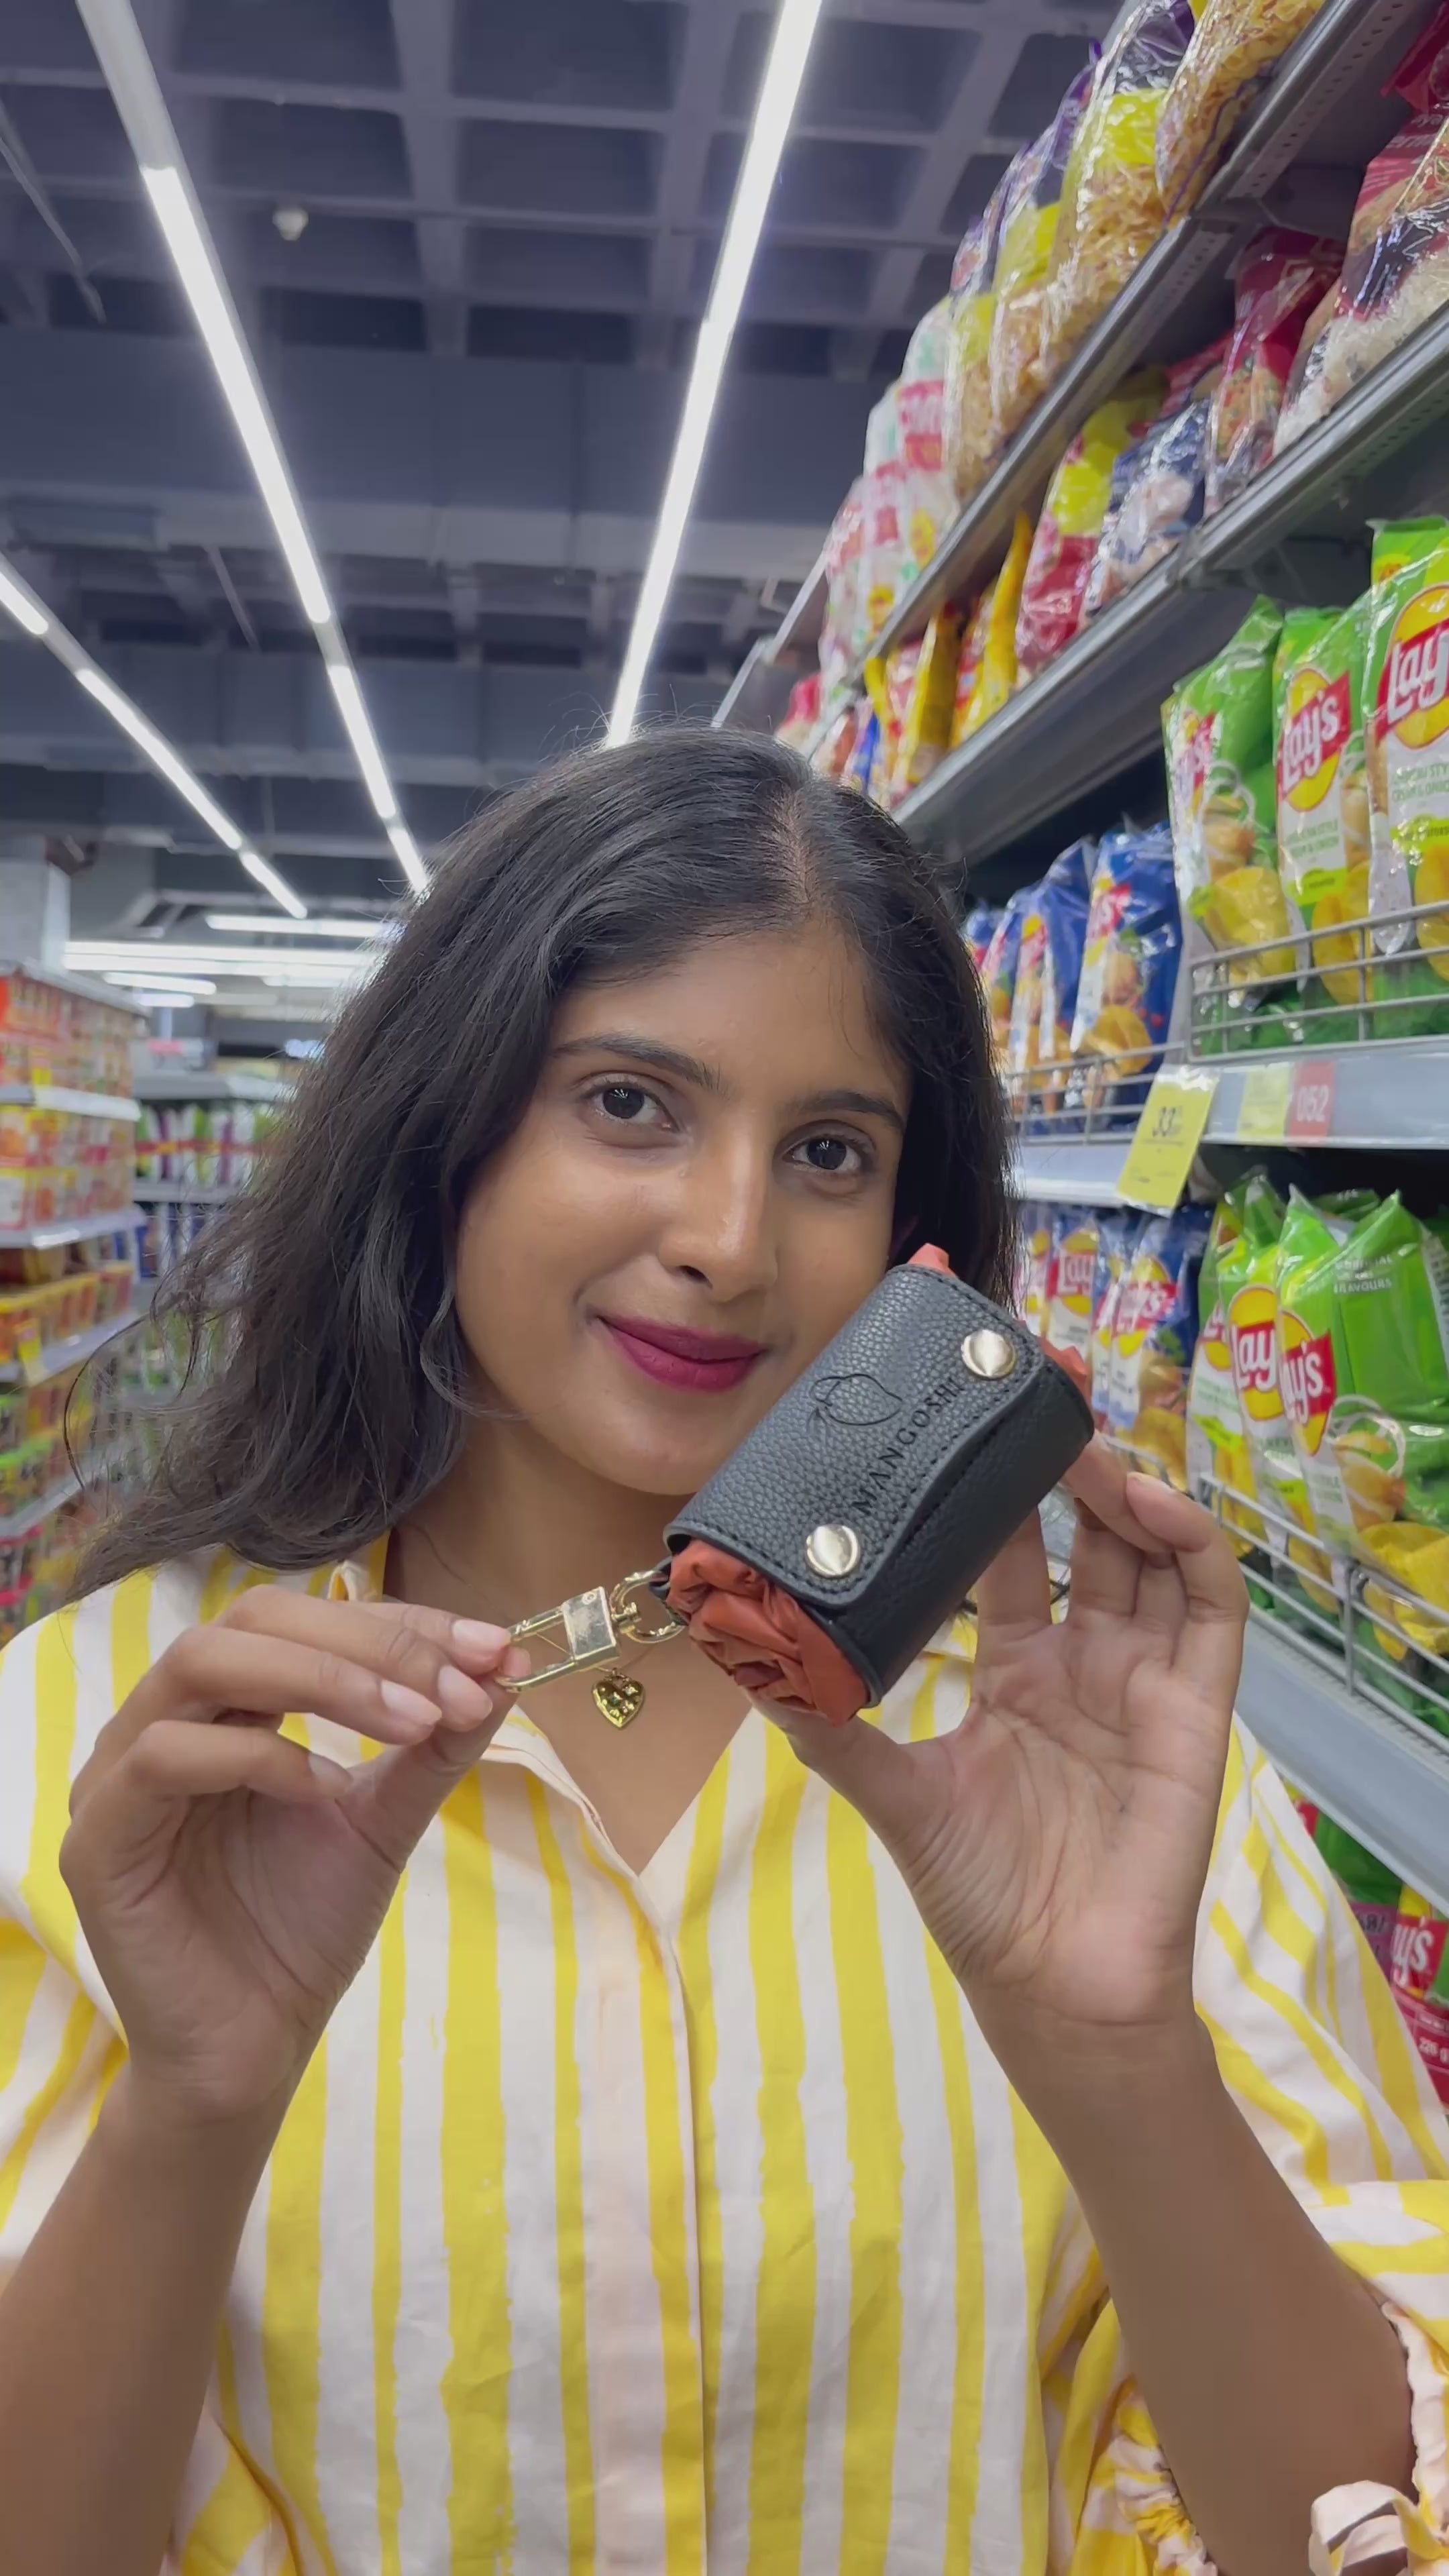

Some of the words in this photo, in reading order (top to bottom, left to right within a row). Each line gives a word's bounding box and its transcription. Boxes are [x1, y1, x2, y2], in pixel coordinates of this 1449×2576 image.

[1387, 631, 1449, 724] Lay
[1282, 690, 1341, 793] Lay's
[1058, 1252, 1095, 1295] Lay
[1230, 1323, 1277, 1392] Lay
[851, 1377, 965, 1516] MANGOSHI
